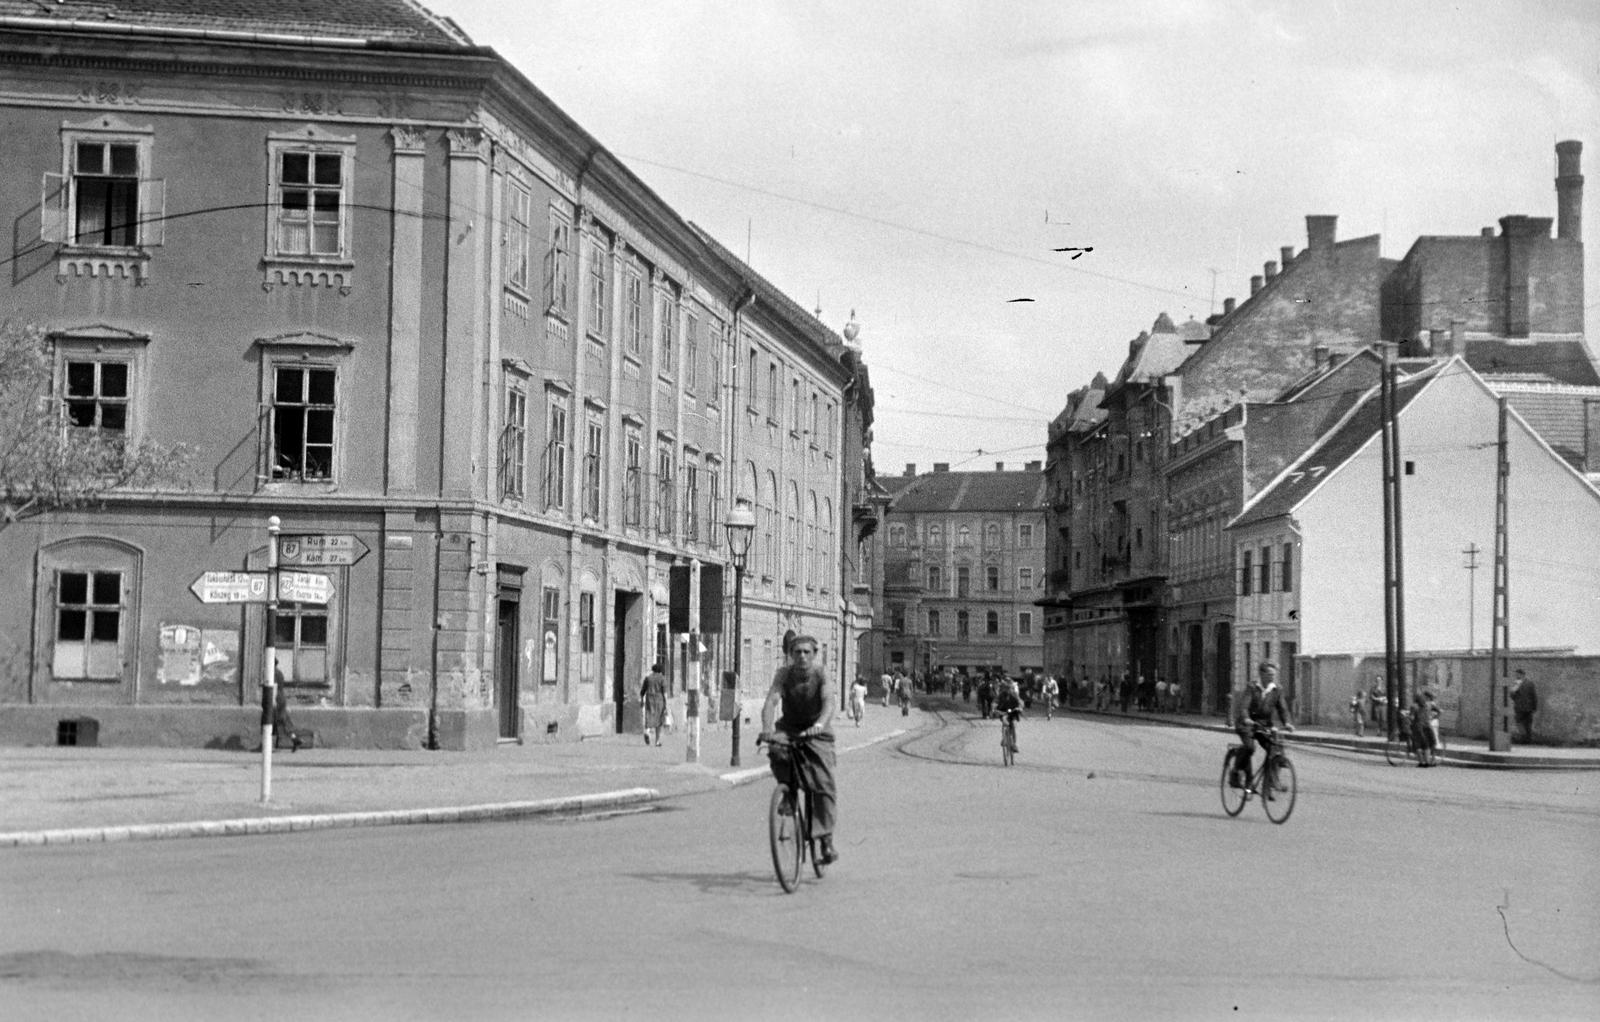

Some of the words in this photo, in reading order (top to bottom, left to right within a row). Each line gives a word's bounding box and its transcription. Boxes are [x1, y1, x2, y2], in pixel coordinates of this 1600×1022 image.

[307, 536, 326, 546] Rum
[331, 538, 339, 546] 22
[286, 543, 297, 554] 87
[330, 554, 338, 562] 27
[253, 580, 264, 592] 87
